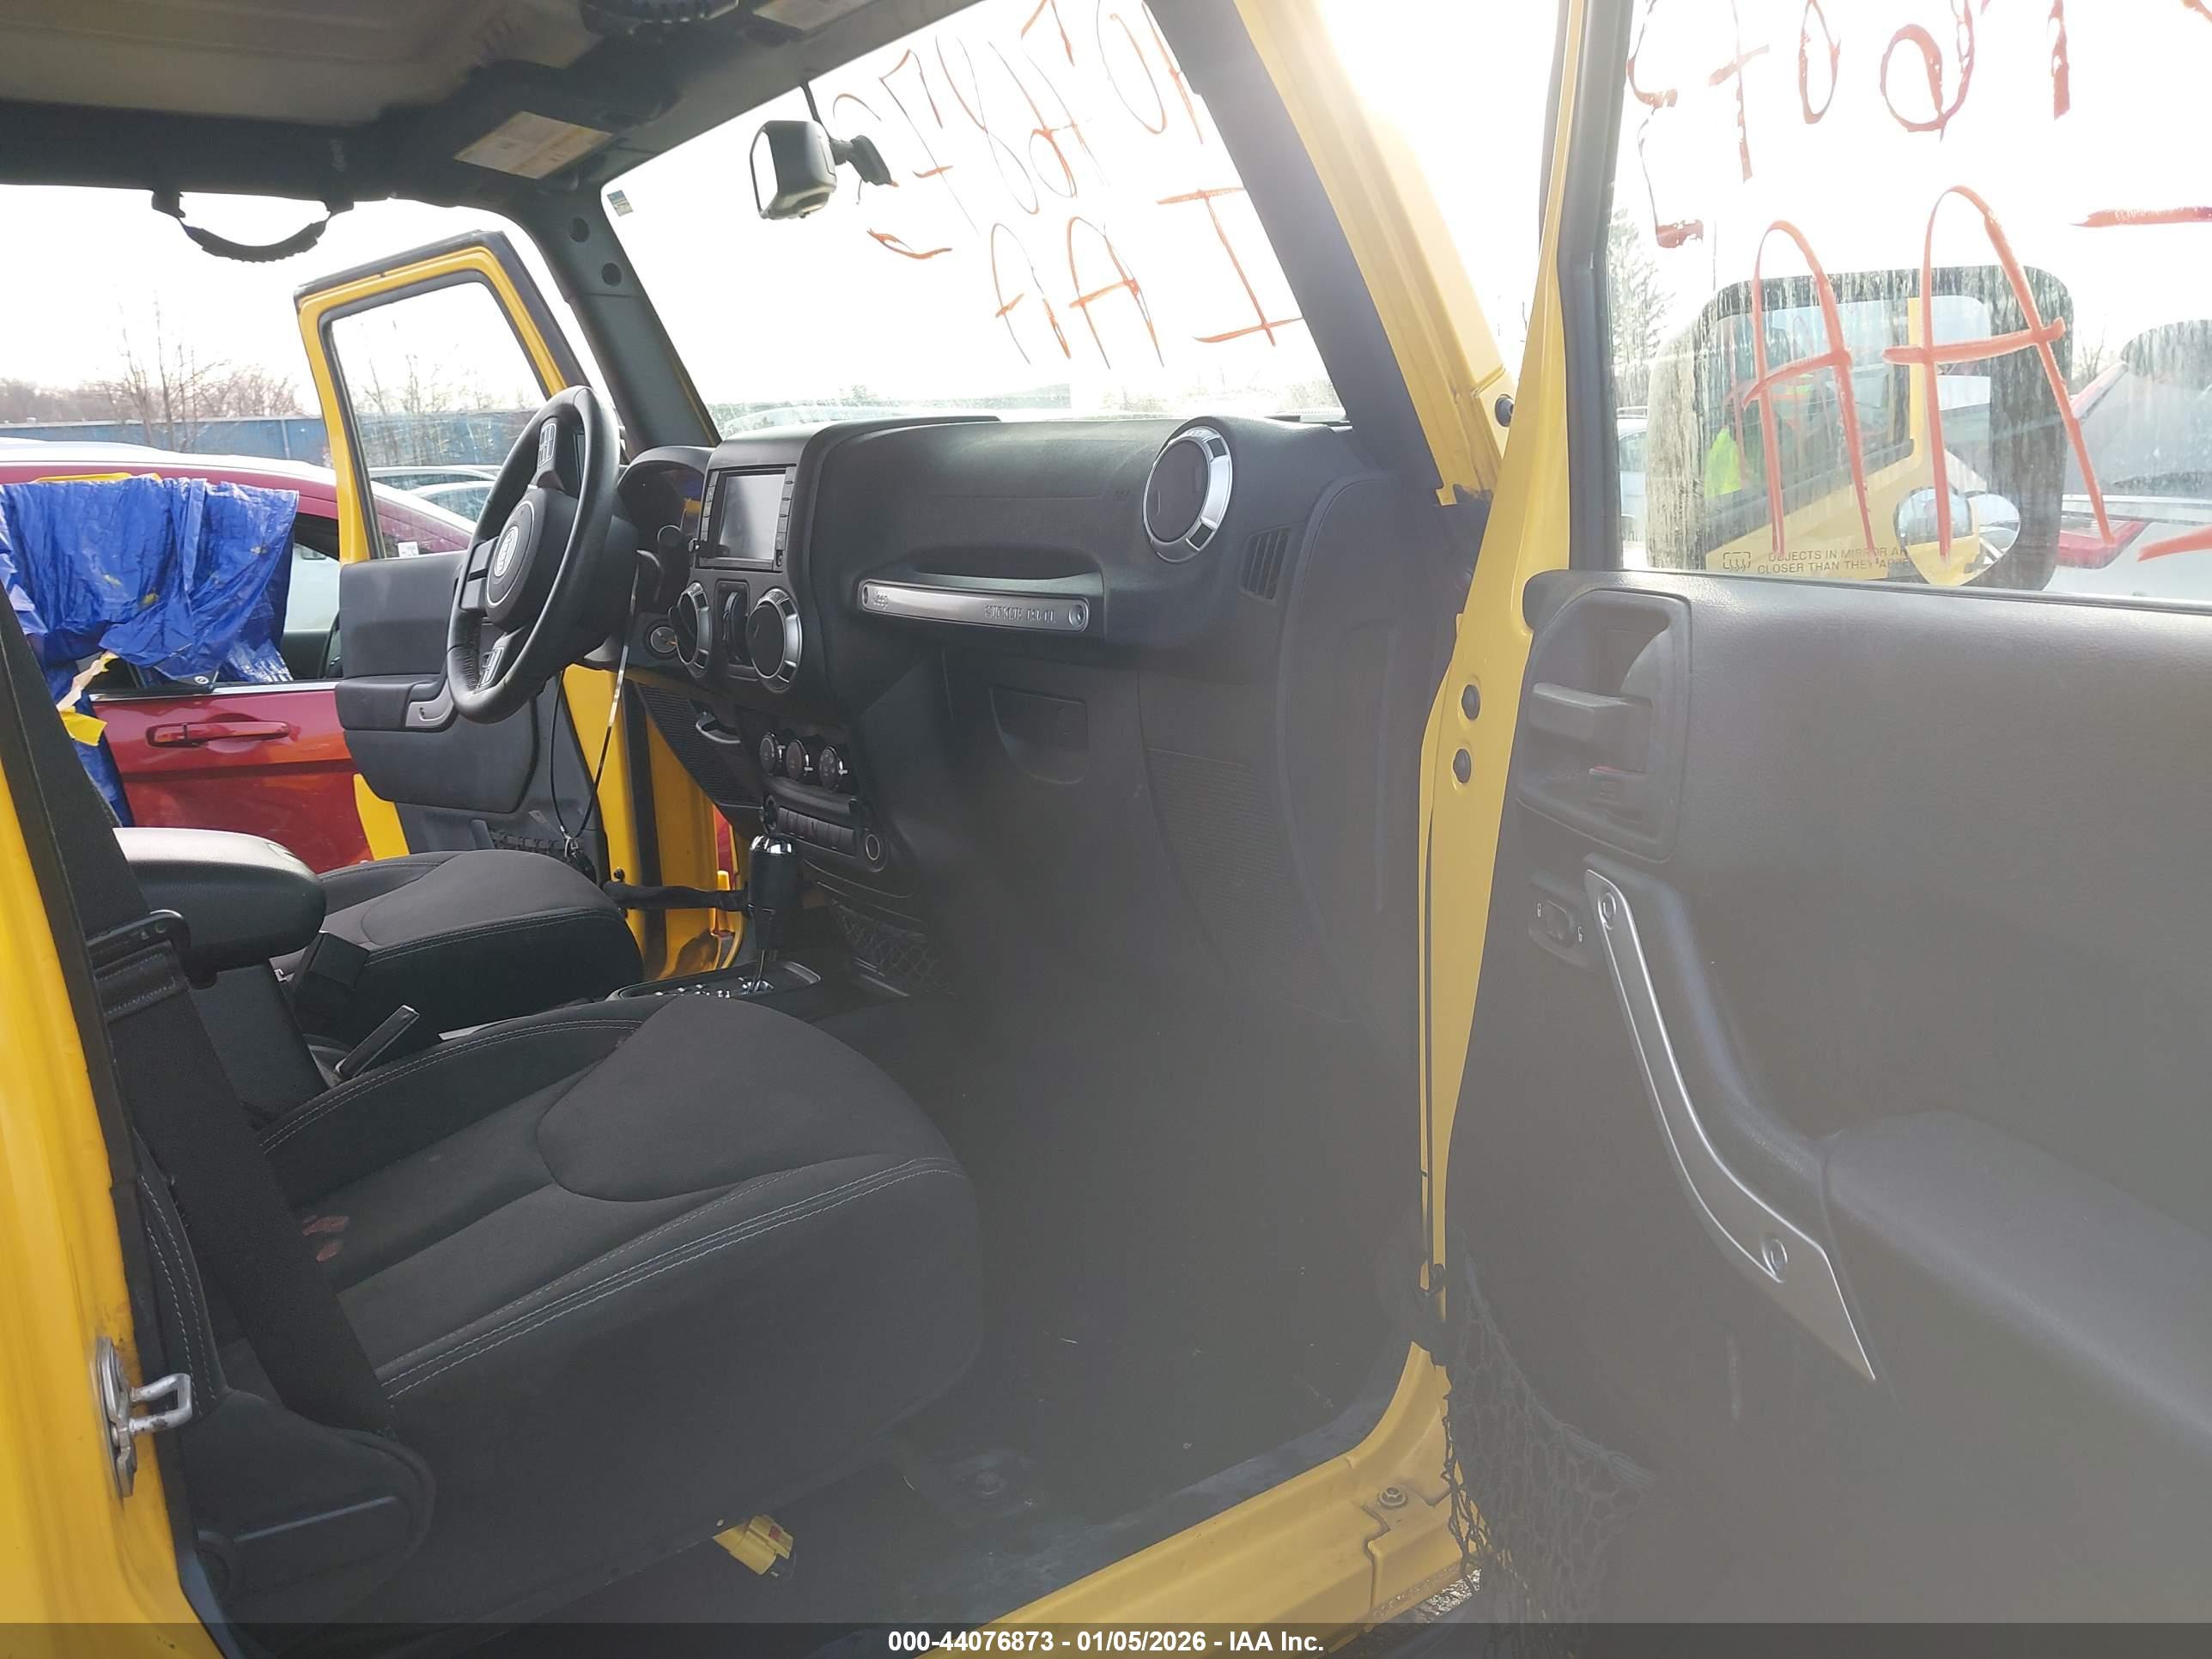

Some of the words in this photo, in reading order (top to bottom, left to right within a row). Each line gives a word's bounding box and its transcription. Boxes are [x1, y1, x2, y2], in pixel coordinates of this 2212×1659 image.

[1768, 550, 1821, 562] OBJECTS
[1826, 549, 1837, 559] IN
[1758, 562, 1804, 574] CLOSER
[1808, 561, 1840, 571] THAN
